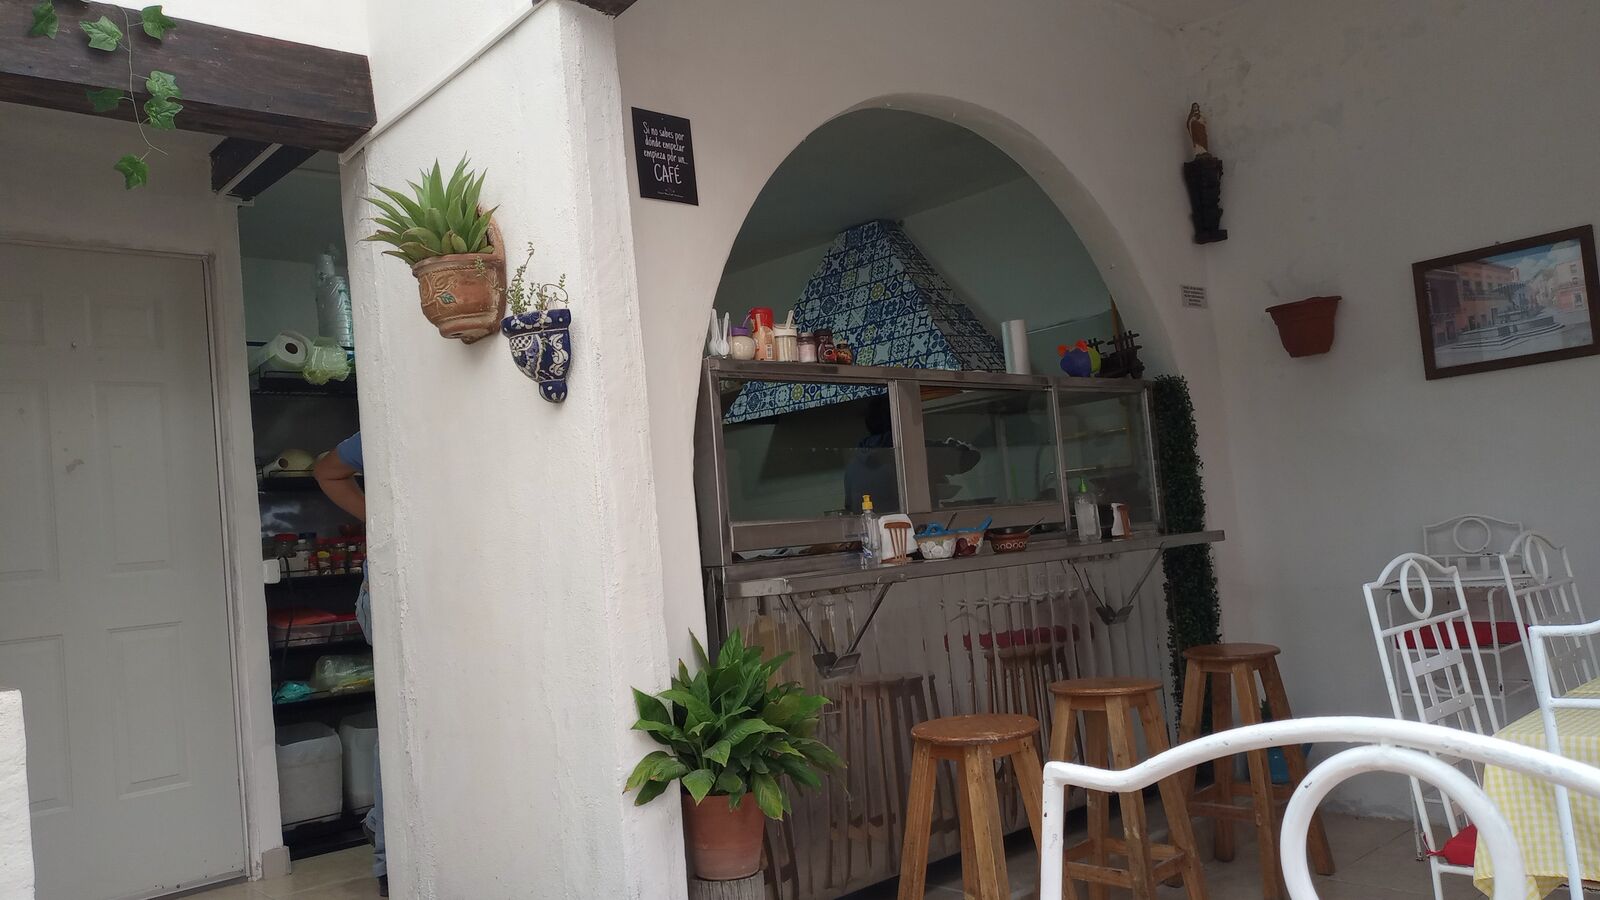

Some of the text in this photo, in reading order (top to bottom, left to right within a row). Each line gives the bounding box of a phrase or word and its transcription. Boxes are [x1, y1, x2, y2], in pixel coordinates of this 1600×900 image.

[642, 121, 650, 134] Si
[658, 127, 674, 139] sabes
[675, 133, 684, 145] por
[662, 142, 685, 154] empezar
[644, 150, 666, 163] empieza
[667, 153, 676, 165] por
[654, 164, 682, 184] CAFÉ
